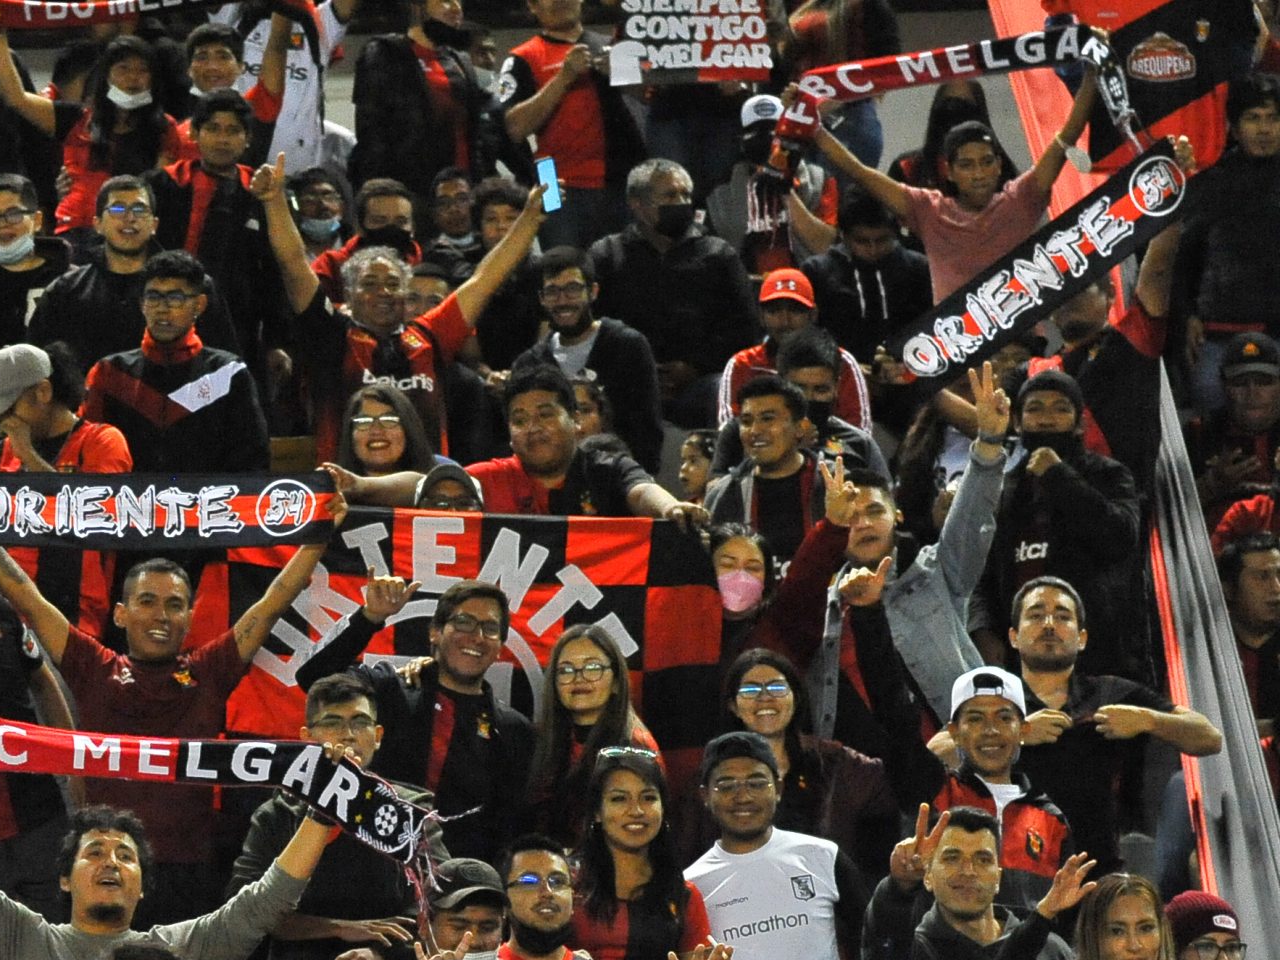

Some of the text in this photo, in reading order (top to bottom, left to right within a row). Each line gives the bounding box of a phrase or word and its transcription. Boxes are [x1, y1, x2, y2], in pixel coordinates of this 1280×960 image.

[625, 14, 767, 41] CONTIGO
[646, 43, 774, 69] MELGAR
[784, 25, 1111, 126] FBC MELGAR
[903, 161, 1179, 377] ORIENTE 54
[266, 488, 305, 527] 54
[72, 734, 361, 824] MELGAR
[715, 896, 749, 909] marathon
[723, 913, 809, 942] marathon
